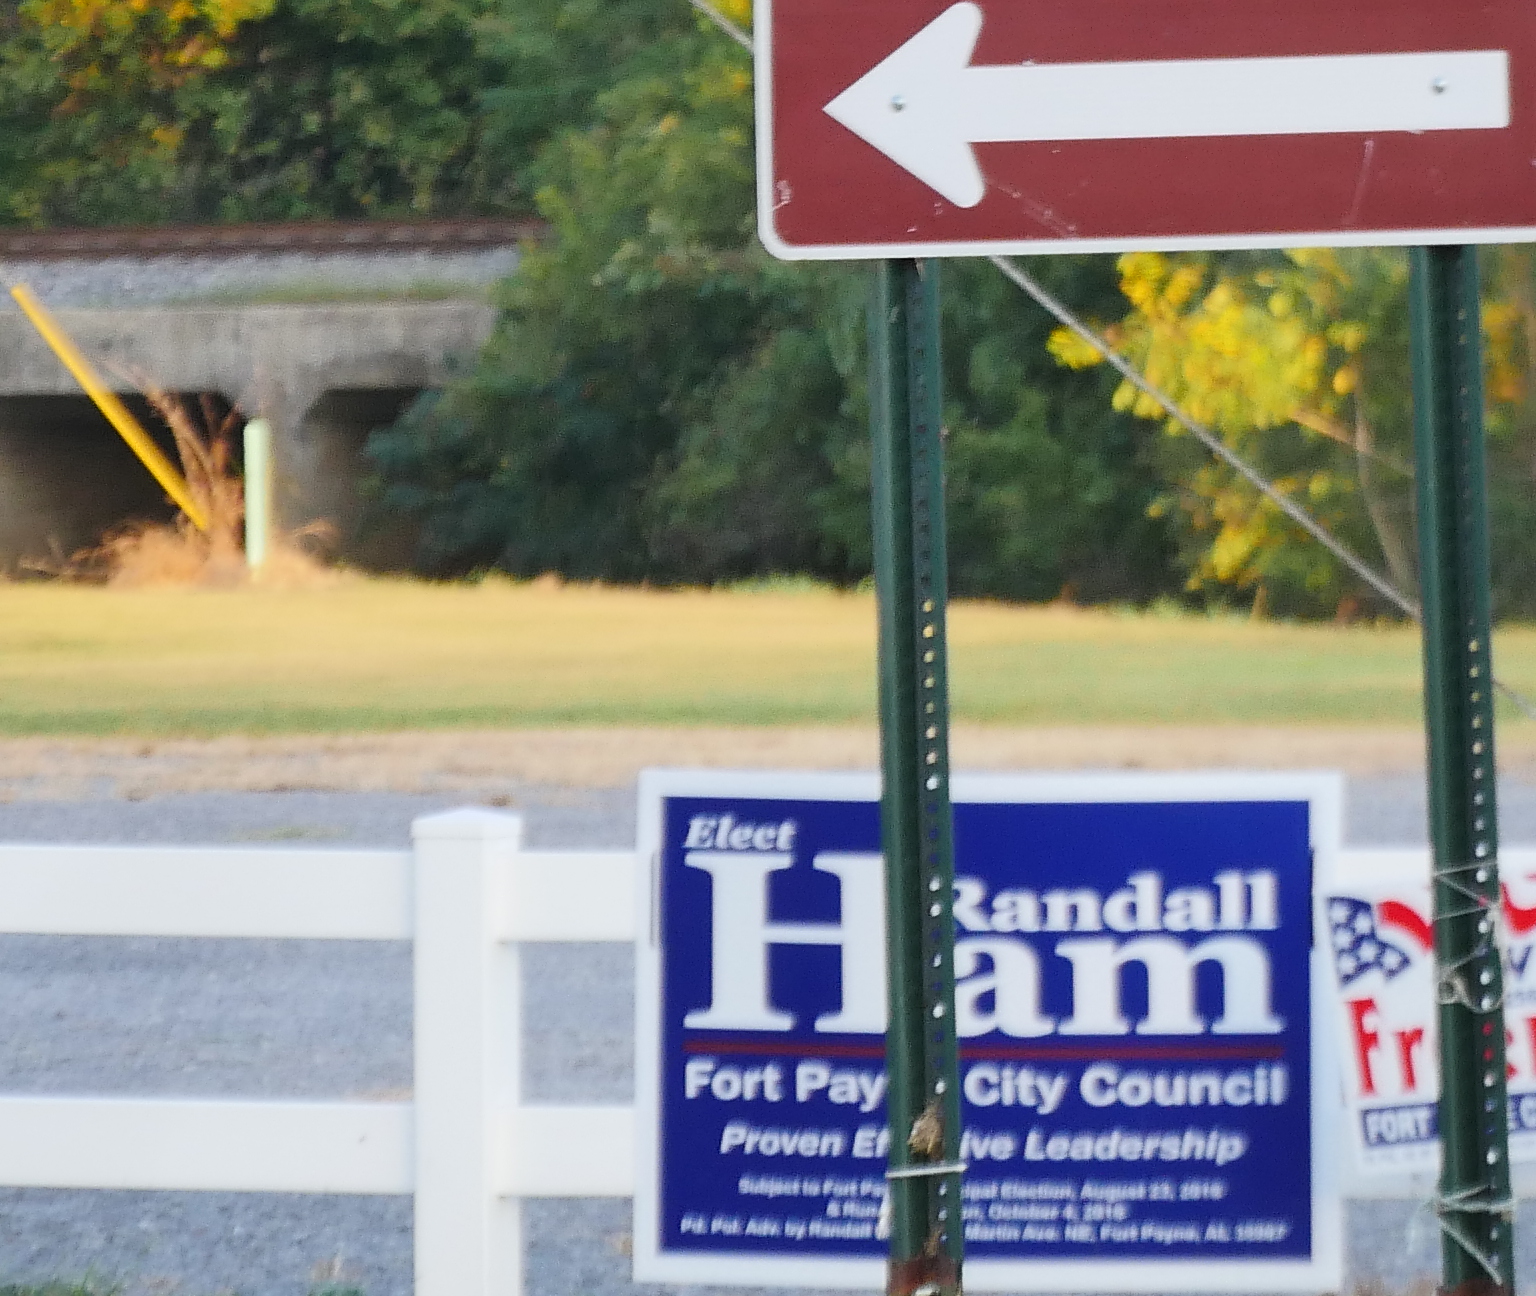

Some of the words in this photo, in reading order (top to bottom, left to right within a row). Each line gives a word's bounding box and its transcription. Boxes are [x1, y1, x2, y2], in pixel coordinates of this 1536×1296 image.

[682, 813, 797, 851] Elect
[953, 870, 1279, 933] Randall
[683, 851, 1286, 1037] Ham
[684, 1056, 783, 1102] Fort
[795, 1059, 890, 1113] Pay
[963, 1062, 1069, 1115] City
[1080, 1062, 1288, 1107] Council
[720, 1120, 844, 1158] Proven
[1023, 1125, 1247, 1166] Leadership
[1364, 1108, 1432, 1144] FORT
